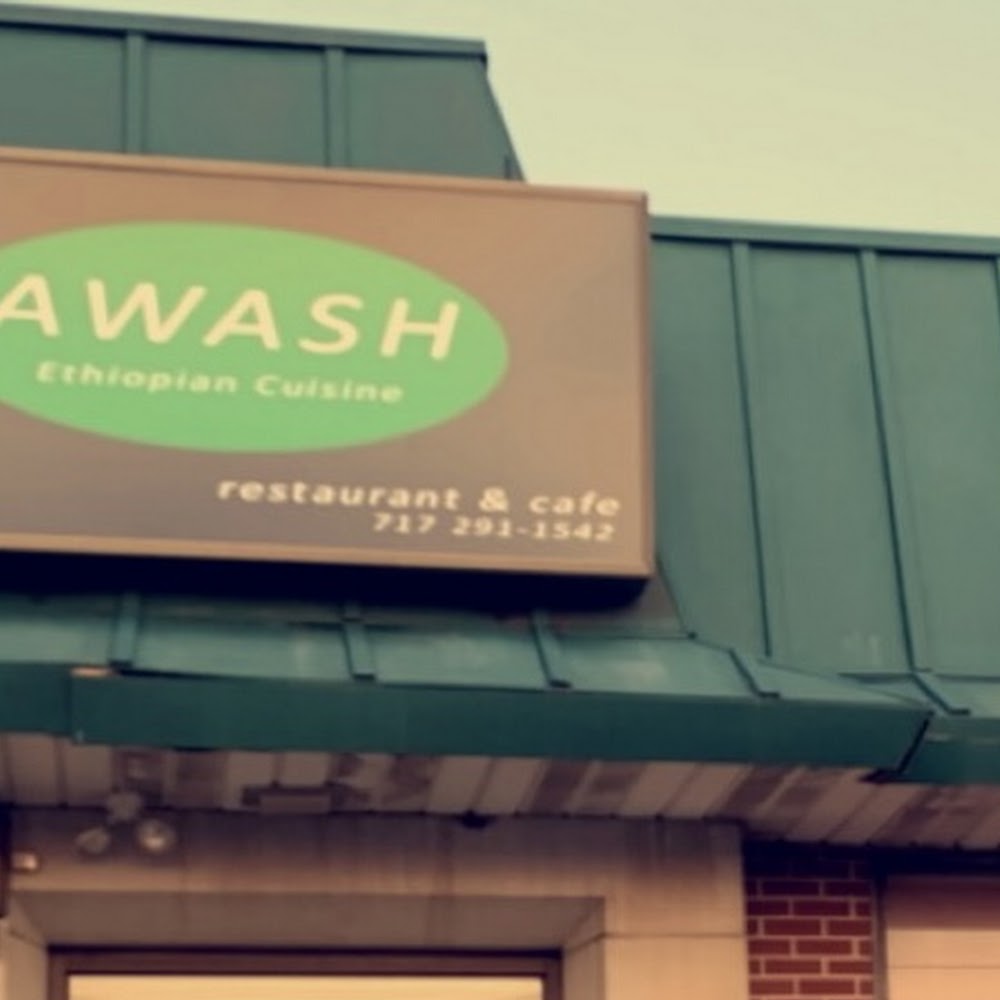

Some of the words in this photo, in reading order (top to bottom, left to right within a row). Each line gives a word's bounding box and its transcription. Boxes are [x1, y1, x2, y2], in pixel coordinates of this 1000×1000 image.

[0, 273, 460, 360] AWASH
[35, 360, 239, 393] Ethiopian
[253, 373, 404, 404] Cuisine
[217, 478, 461, 511] restaurant
[478, 486, 510, 513] &
[528, 490, 621, 517] cafe
[372, 511, 437, 535] 717
[451, 515, 616, 543] 291-1542
